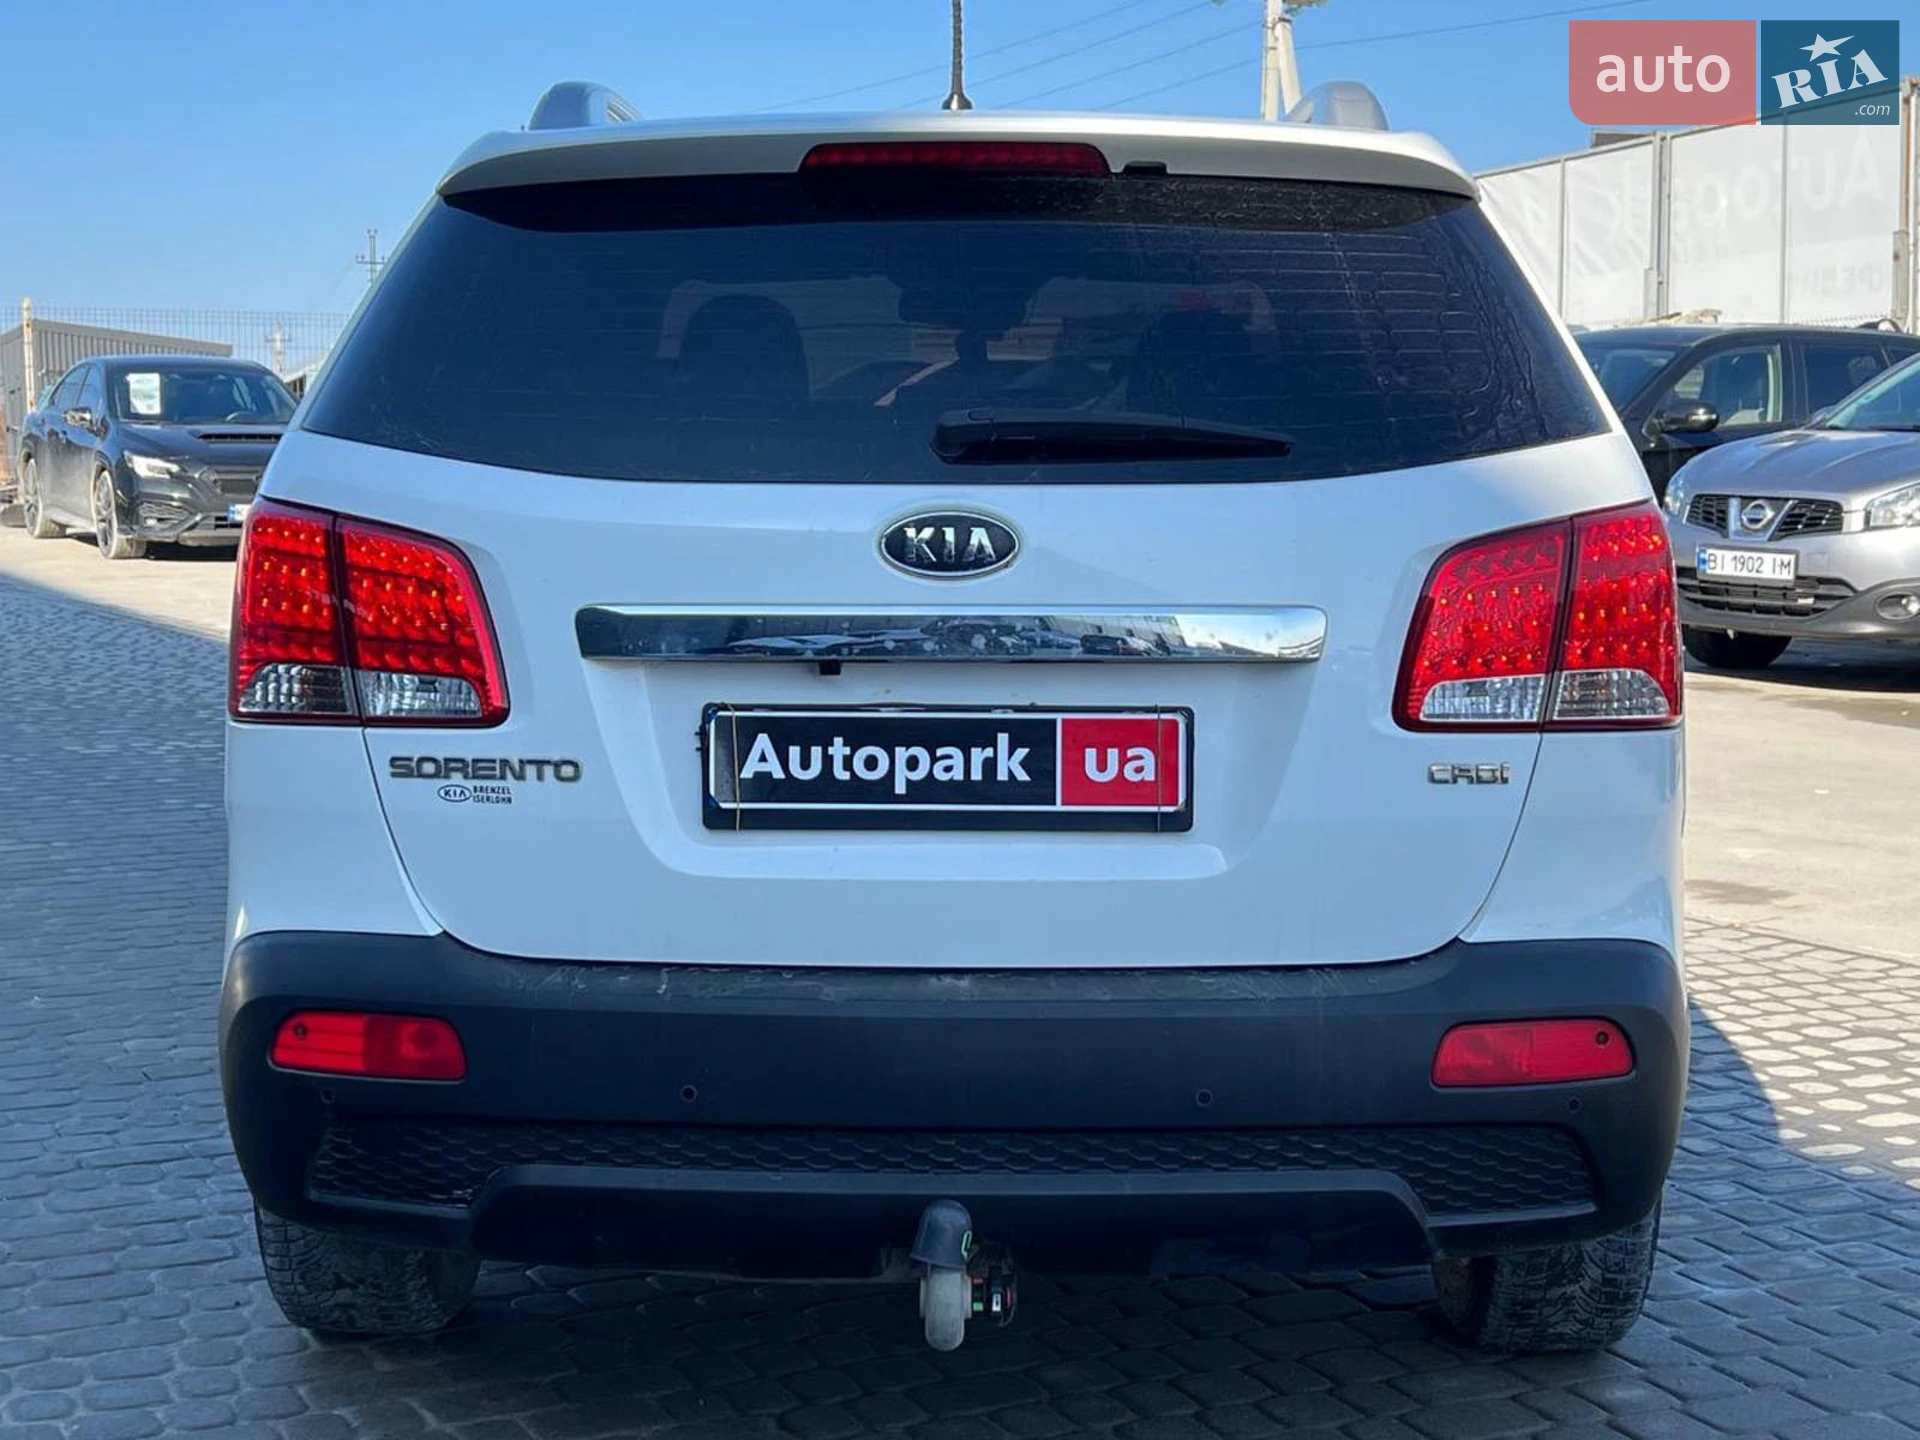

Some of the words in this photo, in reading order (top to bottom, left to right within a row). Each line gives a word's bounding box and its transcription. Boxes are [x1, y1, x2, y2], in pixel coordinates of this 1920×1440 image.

[903, 526, 997, 563] KIA
[1707, 553, 1725, 571] BI
[1731, 555, 1764, 574] 1902
[1772, 558, 1792, 576] IM
[388, 755, 583, 783] SORENTO
[739, 732, 1031, 795] Autopark
[1083, 747, 1156, 782] ua
[472, 795, 512, 804] ISERLOHN
[473, 785, 511, 795] BRENZEL
